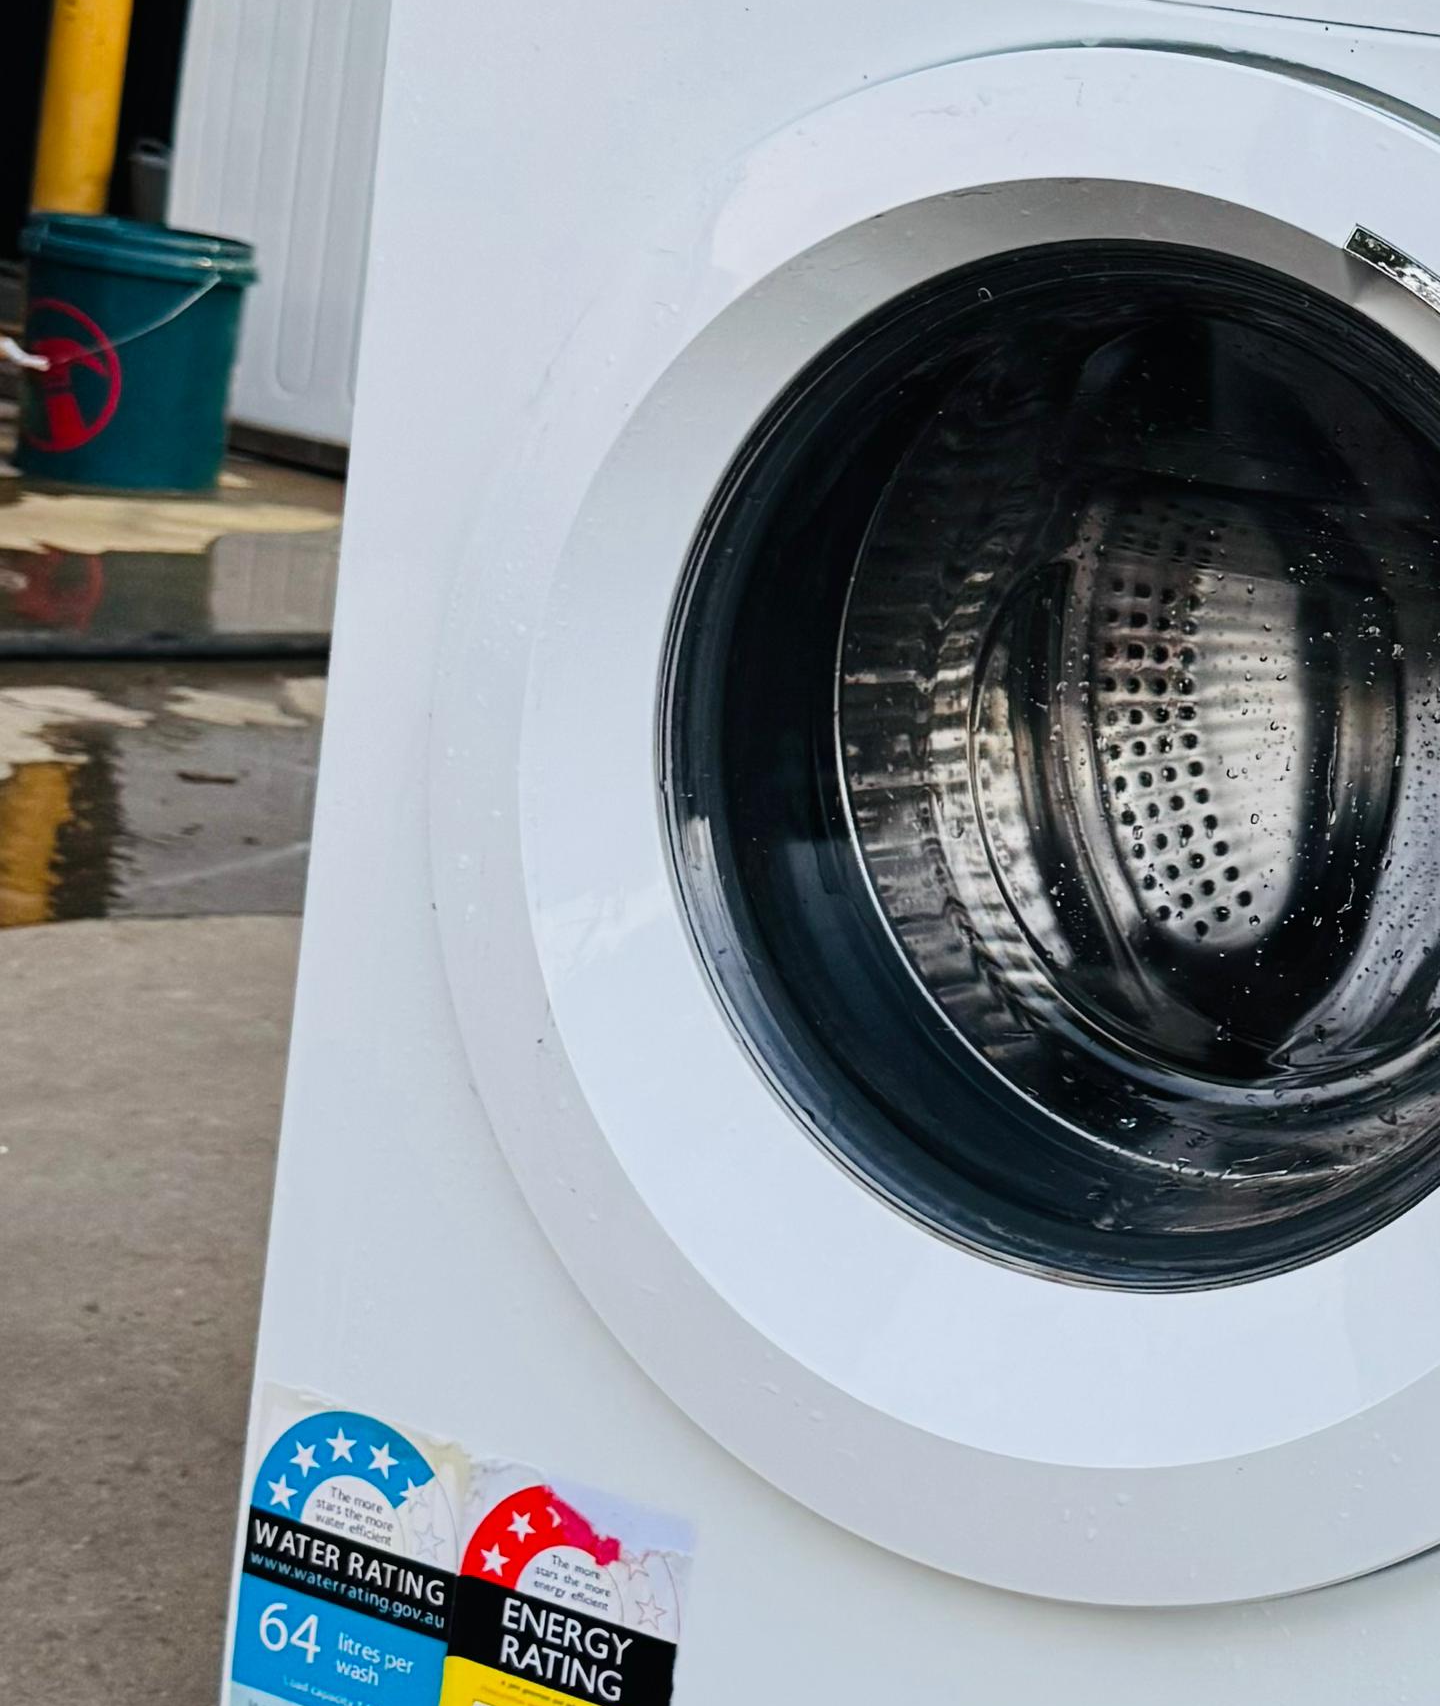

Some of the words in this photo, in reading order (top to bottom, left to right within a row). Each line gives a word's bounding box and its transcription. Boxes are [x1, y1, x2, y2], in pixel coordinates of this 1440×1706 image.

[316, 1499, 341, 1516] stars
[344, 1507, 363, 1523] the
[366, 1516, 394, 1532] more
[330, 1486, 351, 1503] The
[354, 1496, 383, 1513] more
[315, 1513, 345, 1529] water
[349, 1524, 392, 1546] efficient
[255, 1519, 340, 1571] WATER
[349, 1552, 445, 1605] RATING
[552, 1554, 570, 1572] The
[574, 1564, 602, 1580] more
[251, 1551, 445, 1628] www.waterrating.gov.au
[533, 1580, 566, 1599] energy
[571, 1592, 609, 1611] efficient
[535, 1566, 559, 1581] stars
[563, 1573, 580, 1588] the
[584, 1582, 612, 1598] more
[260, 1603, 321, 1663] 64
[501, 1597, 633, 1665] ENERGY
[338, 1632, 381, 1664] litres
[384, 1652, 415, 1675] per
[500, 1634, 623, 1702] RATING
[336, 1660, 379, 1686] wash
